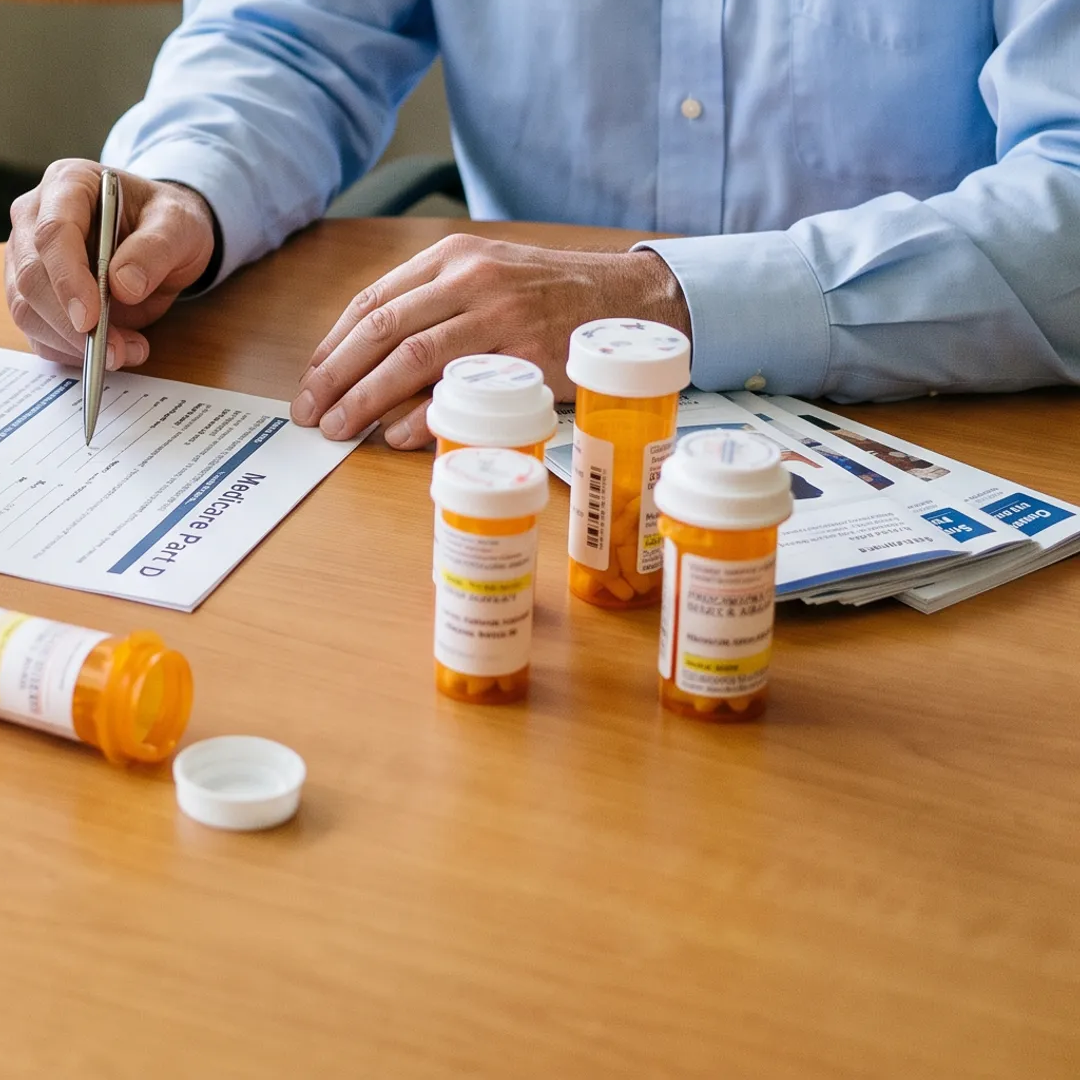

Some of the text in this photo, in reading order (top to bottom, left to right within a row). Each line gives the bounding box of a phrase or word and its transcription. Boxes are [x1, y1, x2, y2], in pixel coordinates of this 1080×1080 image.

[190, 472, 267, 530] Medicare
[152, 533, 203, 563] Part
[139, 566, 166, 577] D
